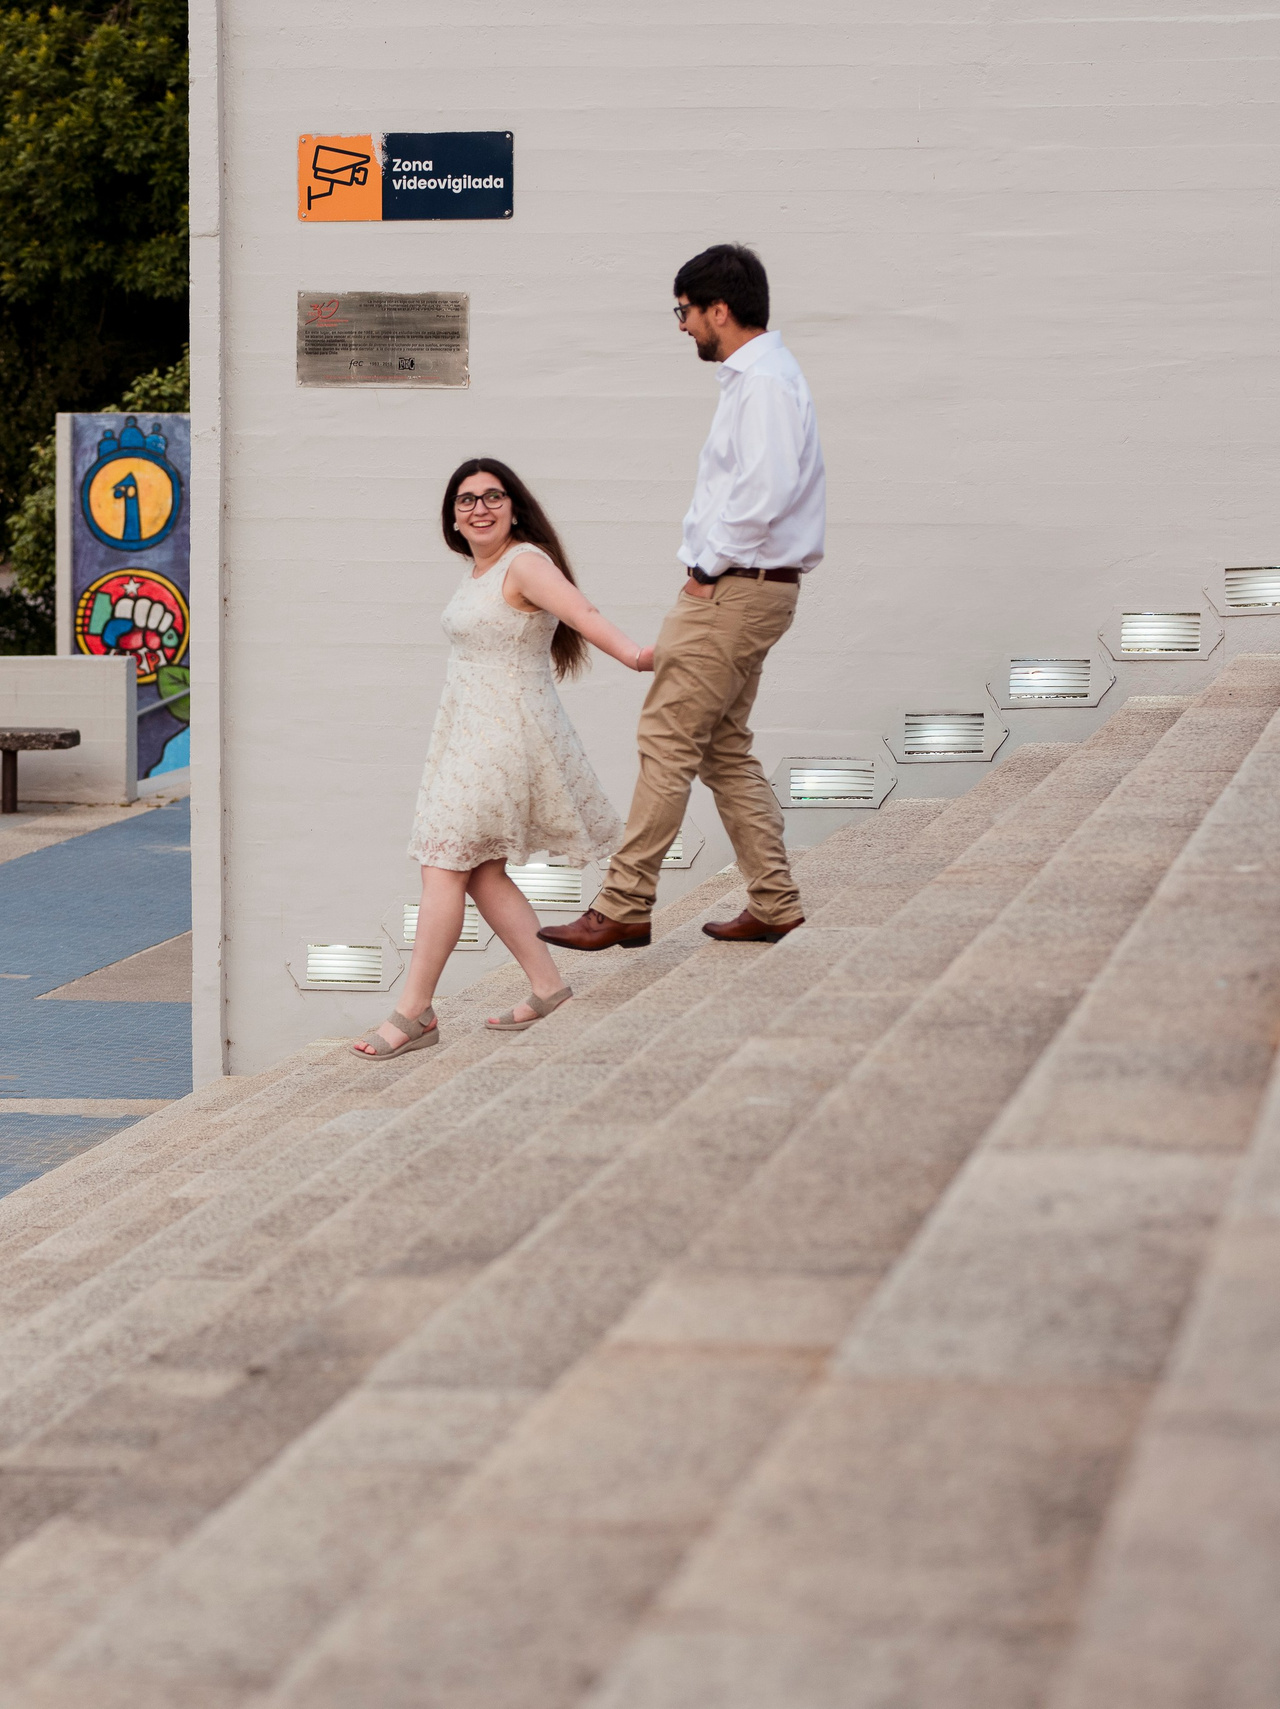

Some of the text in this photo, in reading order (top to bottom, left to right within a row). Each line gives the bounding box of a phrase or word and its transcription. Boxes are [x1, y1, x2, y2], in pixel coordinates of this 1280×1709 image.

[392, 159, 433, 171] Zona
[392, 174, 504, 193] videovigilada
[348, 359, 364, 370] fec
